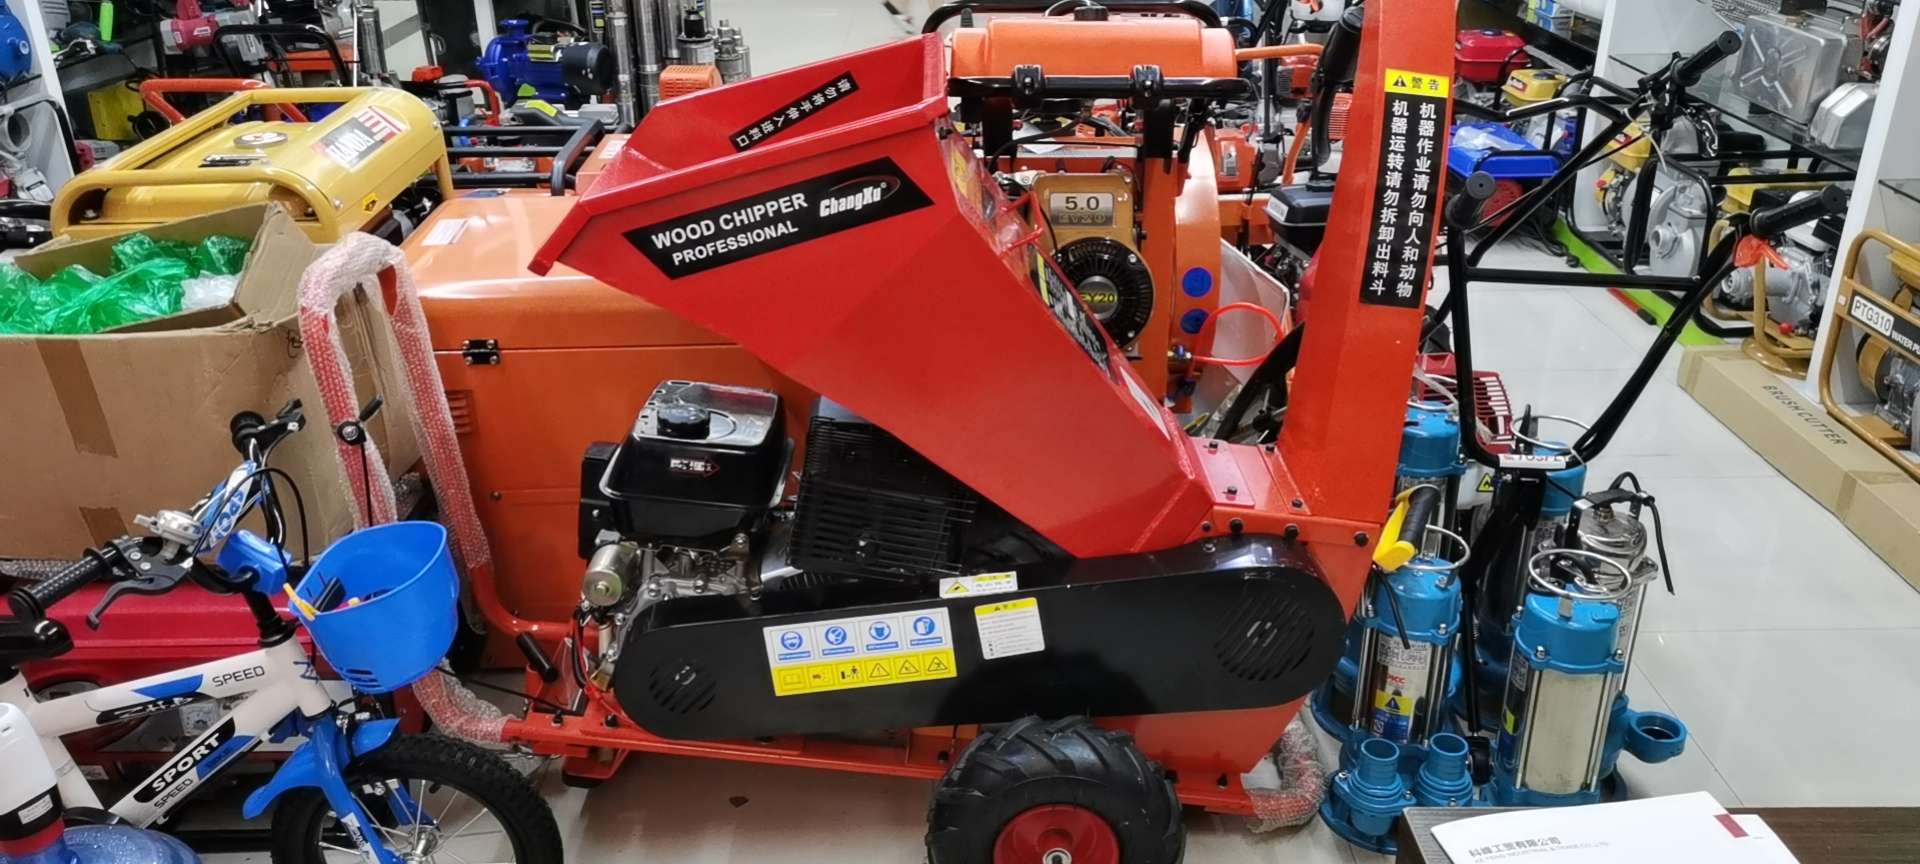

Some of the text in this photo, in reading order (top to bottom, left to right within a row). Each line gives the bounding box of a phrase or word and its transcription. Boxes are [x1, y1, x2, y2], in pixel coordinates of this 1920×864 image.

[651, 192, 808, 250] WOOD CHIPPER
[1065, 196, 1100, 211] 5.0
[1369, 100, 1409, 297] 机器运转请勿拆卸出料斗
[1396, 102, 1436, 298] 机器作业请勿向人和动物
[672, 220, 799, 266] PROFESSIONAL
[1853, 300, 1892, 332] PTG310
[212, 665, 266, 687] SPEED
[152, 732, 221, 793] SPORT
[153, 778, 193, 809] SPEED
